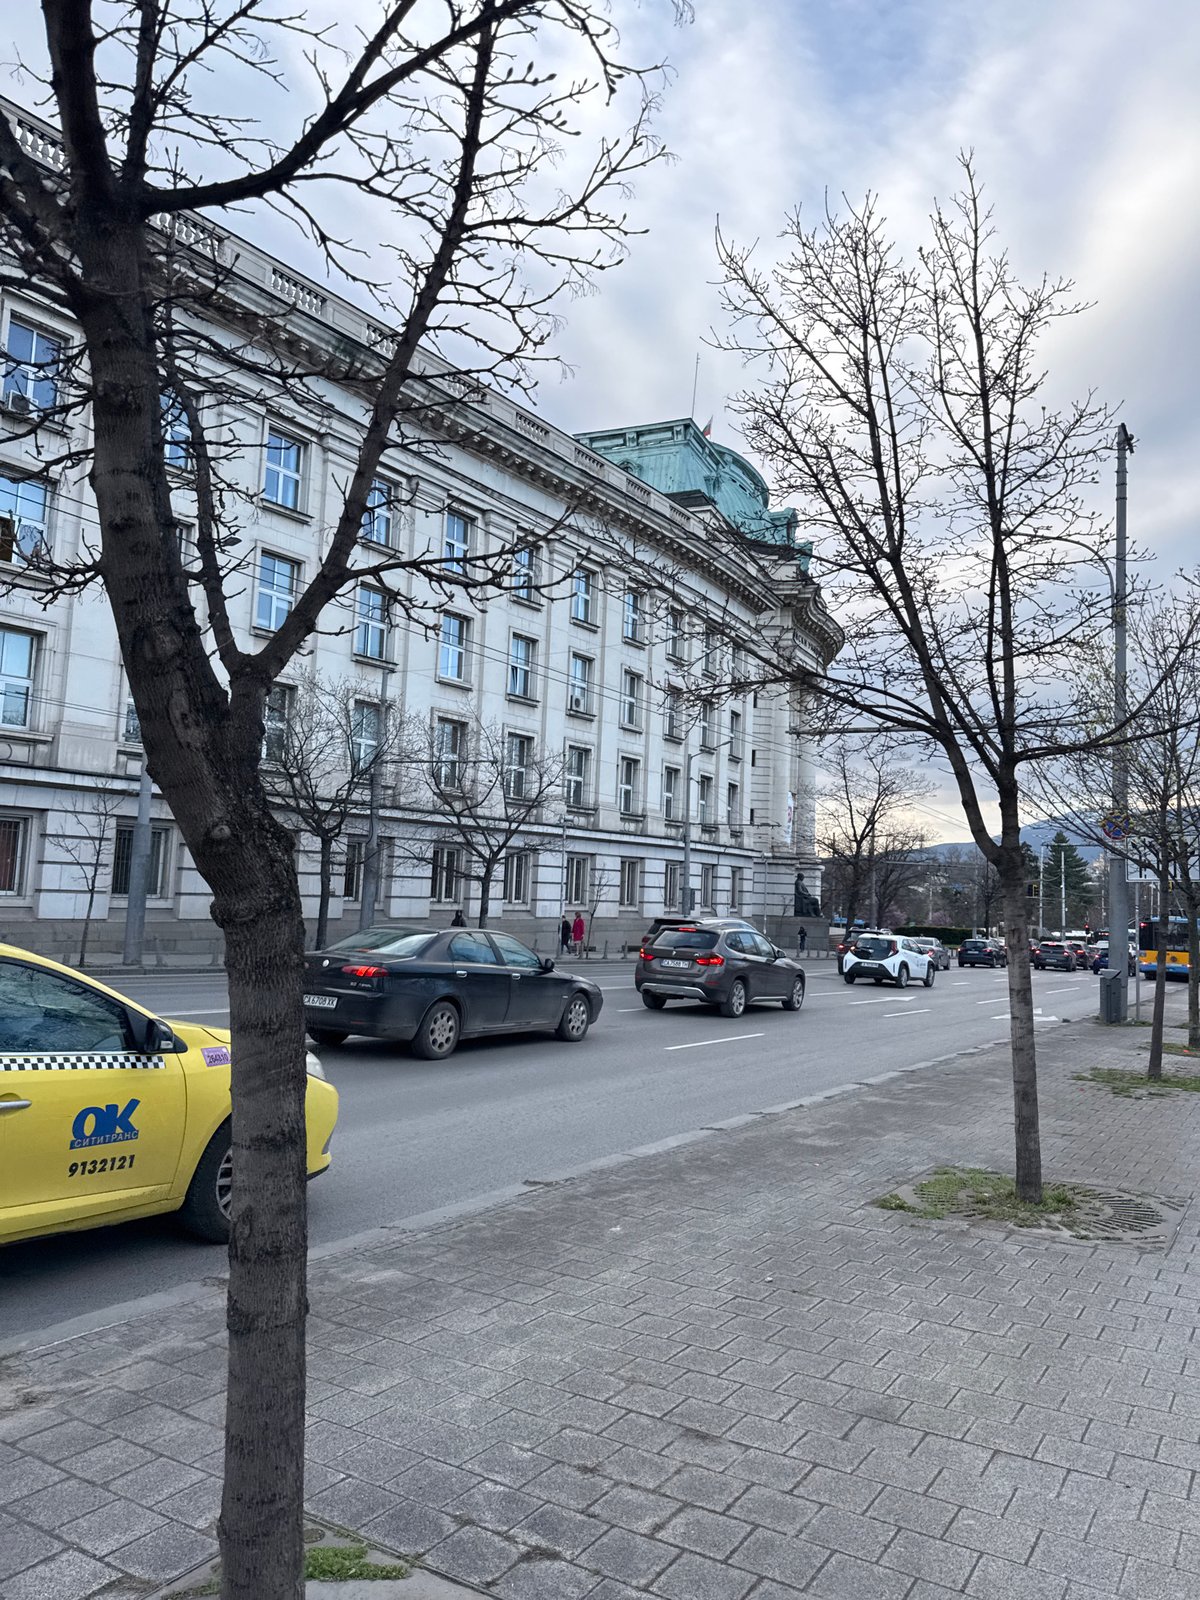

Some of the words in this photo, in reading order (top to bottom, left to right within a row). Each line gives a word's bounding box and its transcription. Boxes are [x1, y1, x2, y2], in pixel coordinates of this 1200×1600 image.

[311, 996, 327, 1006] 6708
[74, 1131, 138, 1148] СИТИТРАНС
[68, 1154, 135, 1177] 9132121
